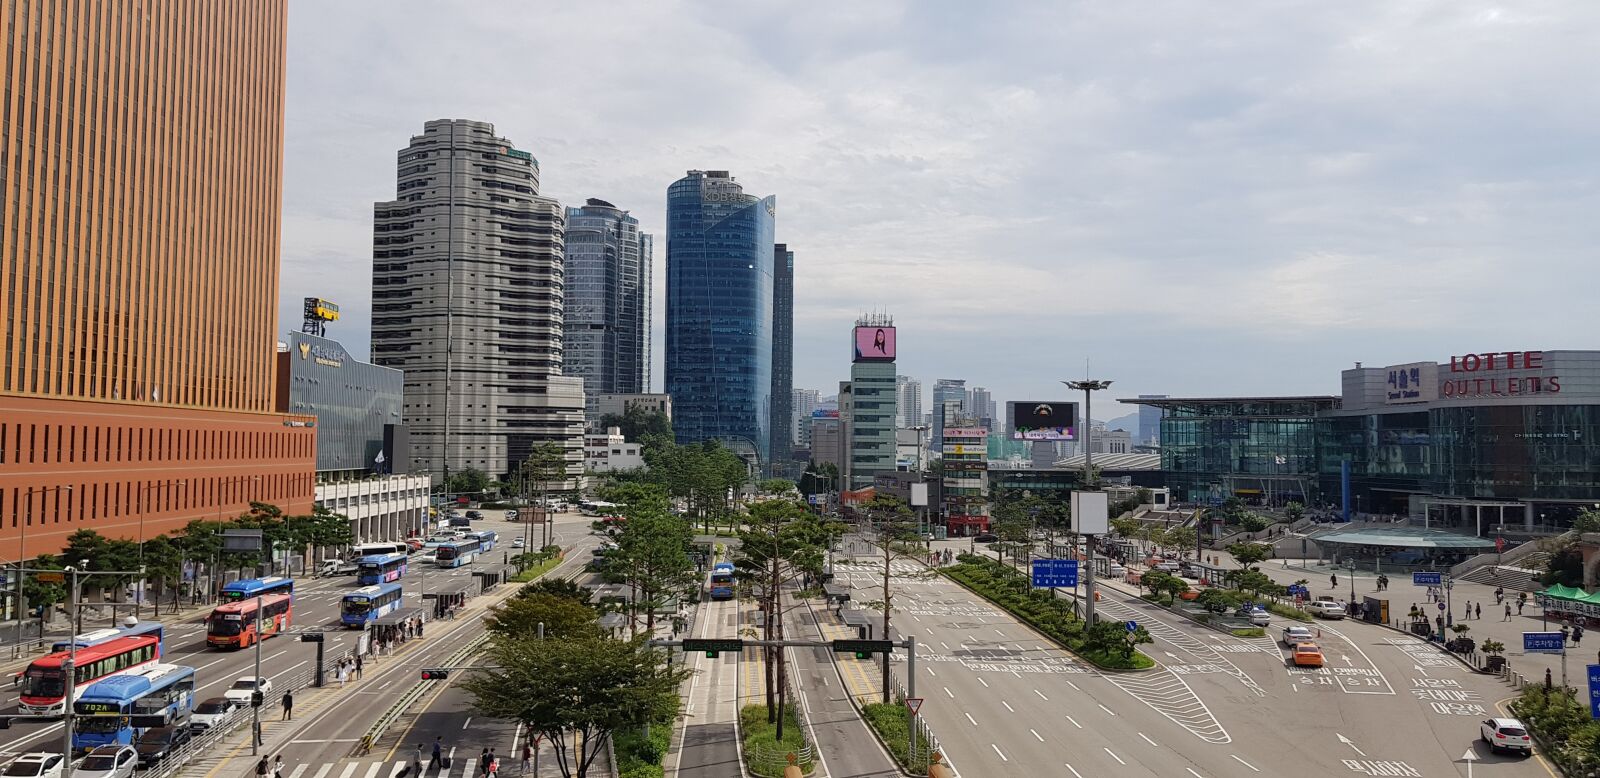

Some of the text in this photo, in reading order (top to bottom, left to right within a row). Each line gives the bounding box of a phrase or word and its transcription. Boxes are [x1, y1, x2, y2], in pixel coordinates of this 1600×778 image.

[1450, 351, 1543, 373] LOTTE
[1388, 368, 1419, 389] 서울역
[1444, 376, 1561, 397] OUTLETS
[1387, 390, 1420, 400] Seoul Station
[1535, 640, 1554, 648] 주차장
[1411, 678, 1462, 689] 서울역
[1409, 688, 1484, 702] 롯데마트
[84, 703, 107, 711] 702A
[1430, 702, 1489, 717] 아울렛
[1340, 759, 1423, 777] 택시하차
